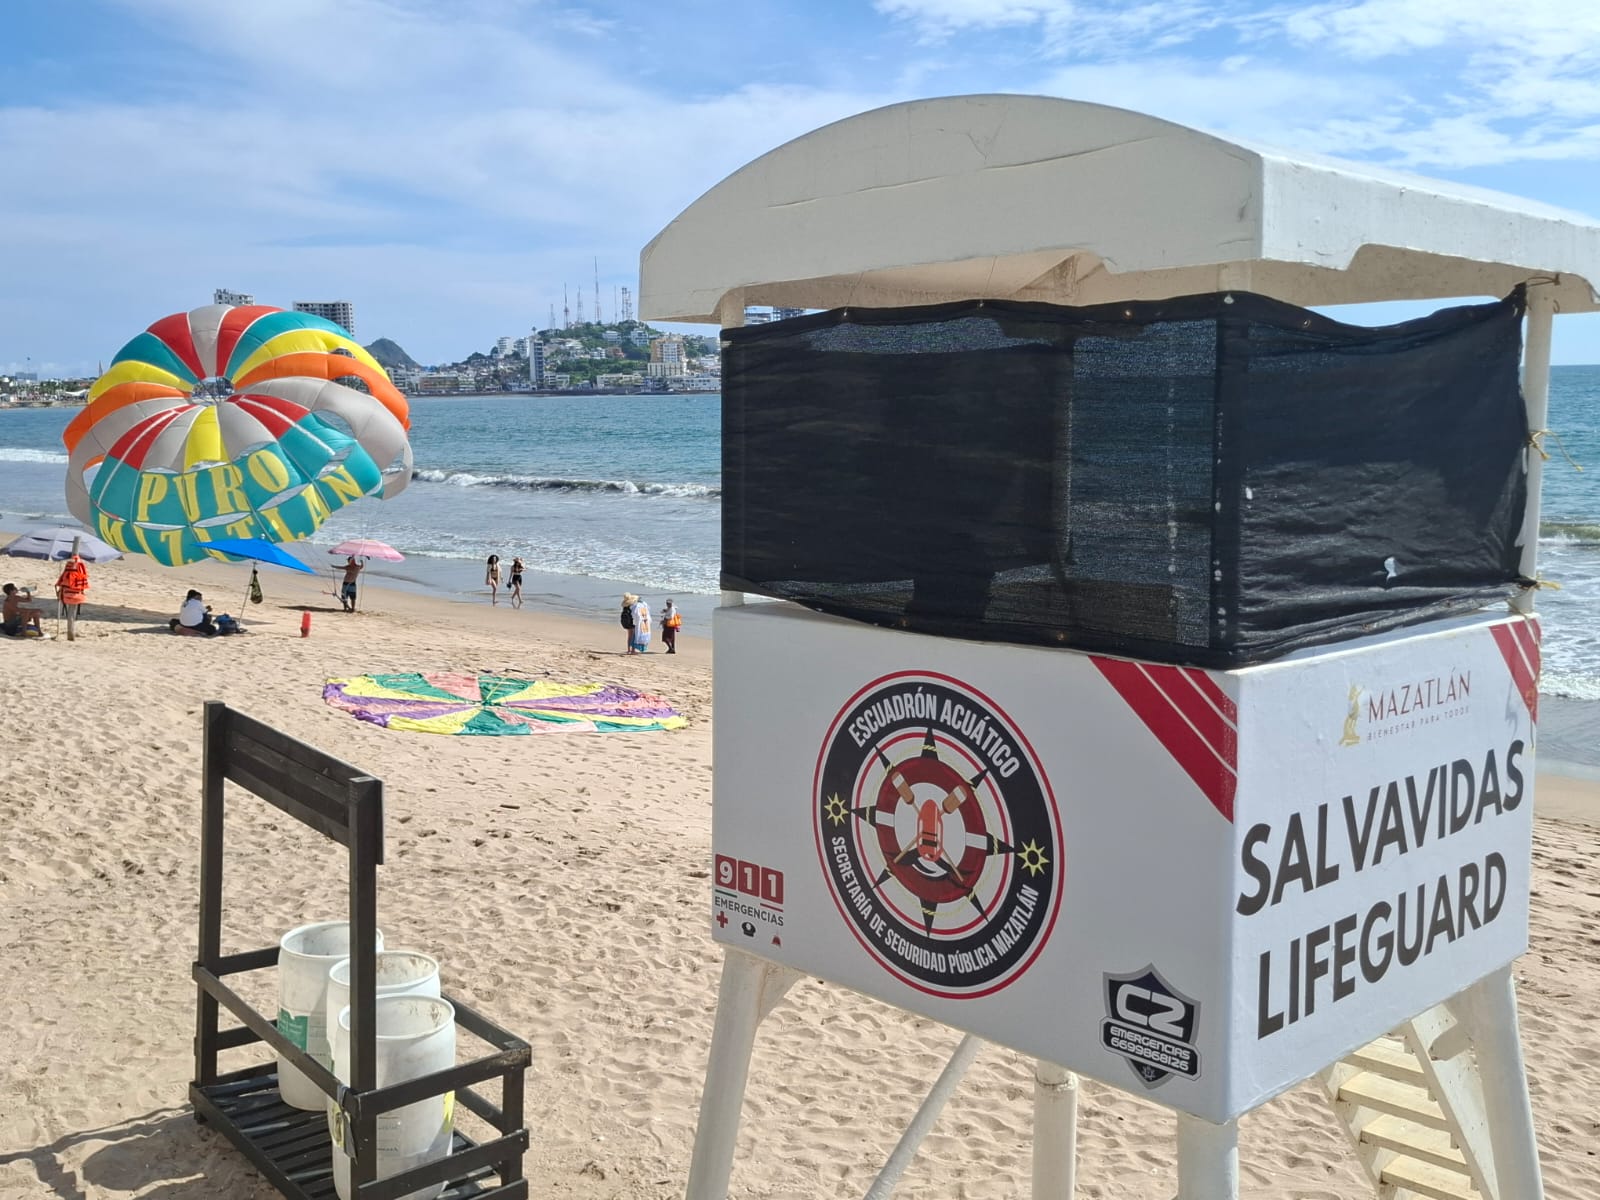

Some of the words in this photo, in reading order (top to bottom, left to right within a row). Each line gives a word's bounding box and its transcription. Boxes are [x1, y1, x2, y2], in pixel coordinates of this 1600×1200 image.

[137, 449, 290, 522] PURO
[1368, 666, 1471, 723] MAZATLÁN
[848, 686, 937, 748] ESCUADRÓN
[940, 698, 1021, 778] ACUÁTICO
[1236, 739, 1524, 916] SALVAVIDAS
[719, 860, 777, 898] 911
[831, 836, 871, 920] SECRETARÍA
[868, 912, 886, 937] DE
[884, 930, 947, 974] SEGURIDAD
[949, 947, 998, 974] PÚBLICA
[995, 884, 1039, 957] MAZATLÁN
[714, 896, 784, 926] EMERGENCIAS
[1258, 851, 1507, 1040] LIFEGUARD
[1116, 983, 1186, 1038] C2
[1110, 1025, 1190, 1060] EMERGENCIAS
[1110, 1037, 1189, 1071] 6699868126
